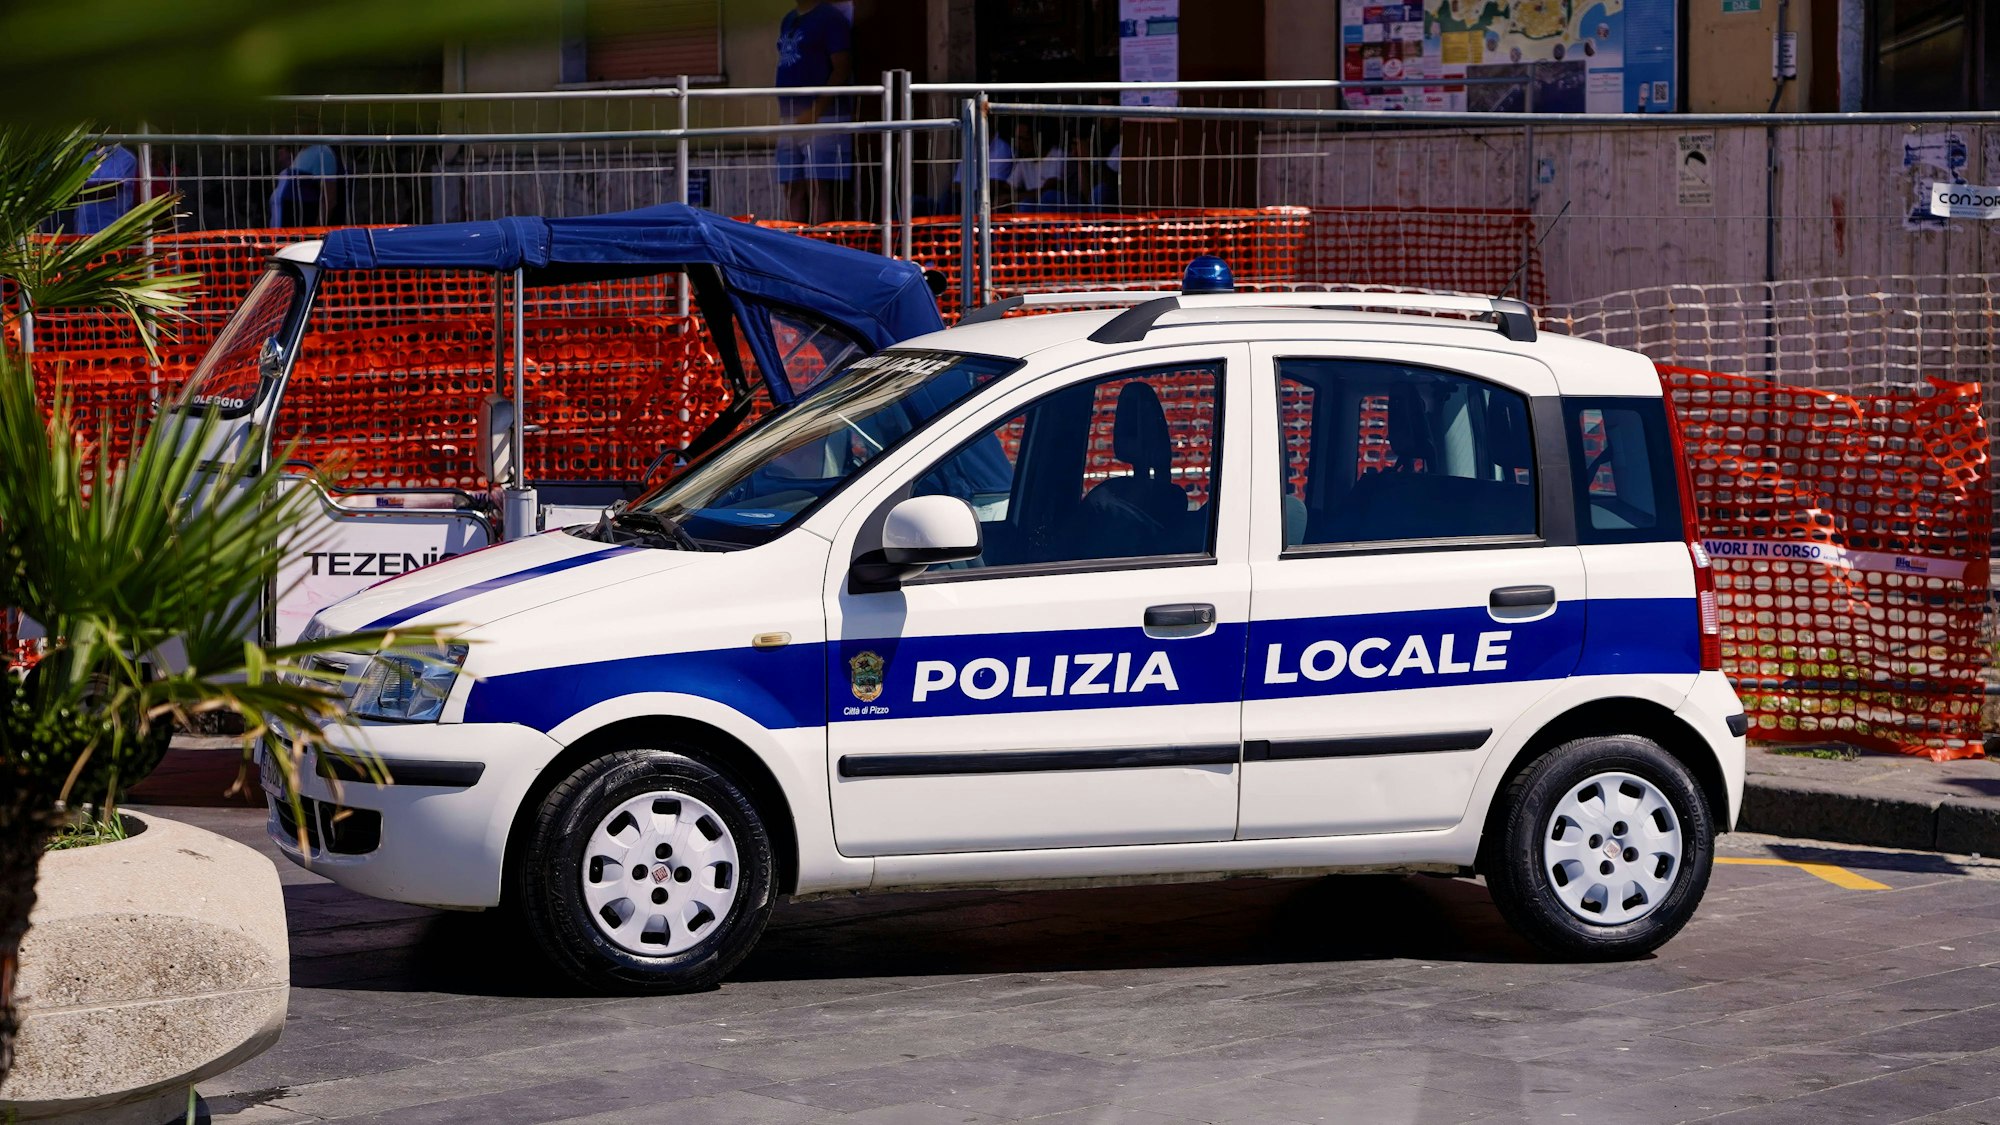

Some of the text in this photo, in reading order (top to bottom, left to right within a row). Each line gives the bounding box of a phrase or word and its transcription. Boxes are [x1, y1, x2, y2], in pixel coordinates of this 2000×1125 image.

[191, 395, 243, 408] OLEGGIO
[1752, 543, 1768, 556] IN
[1773, 544, 1821, 558] CORSO
[912, 631, 1512, 702] POLIZIA LOCALE
[861, 706, 869, 715] di
[869, 706, 889, 715] Pizzo
